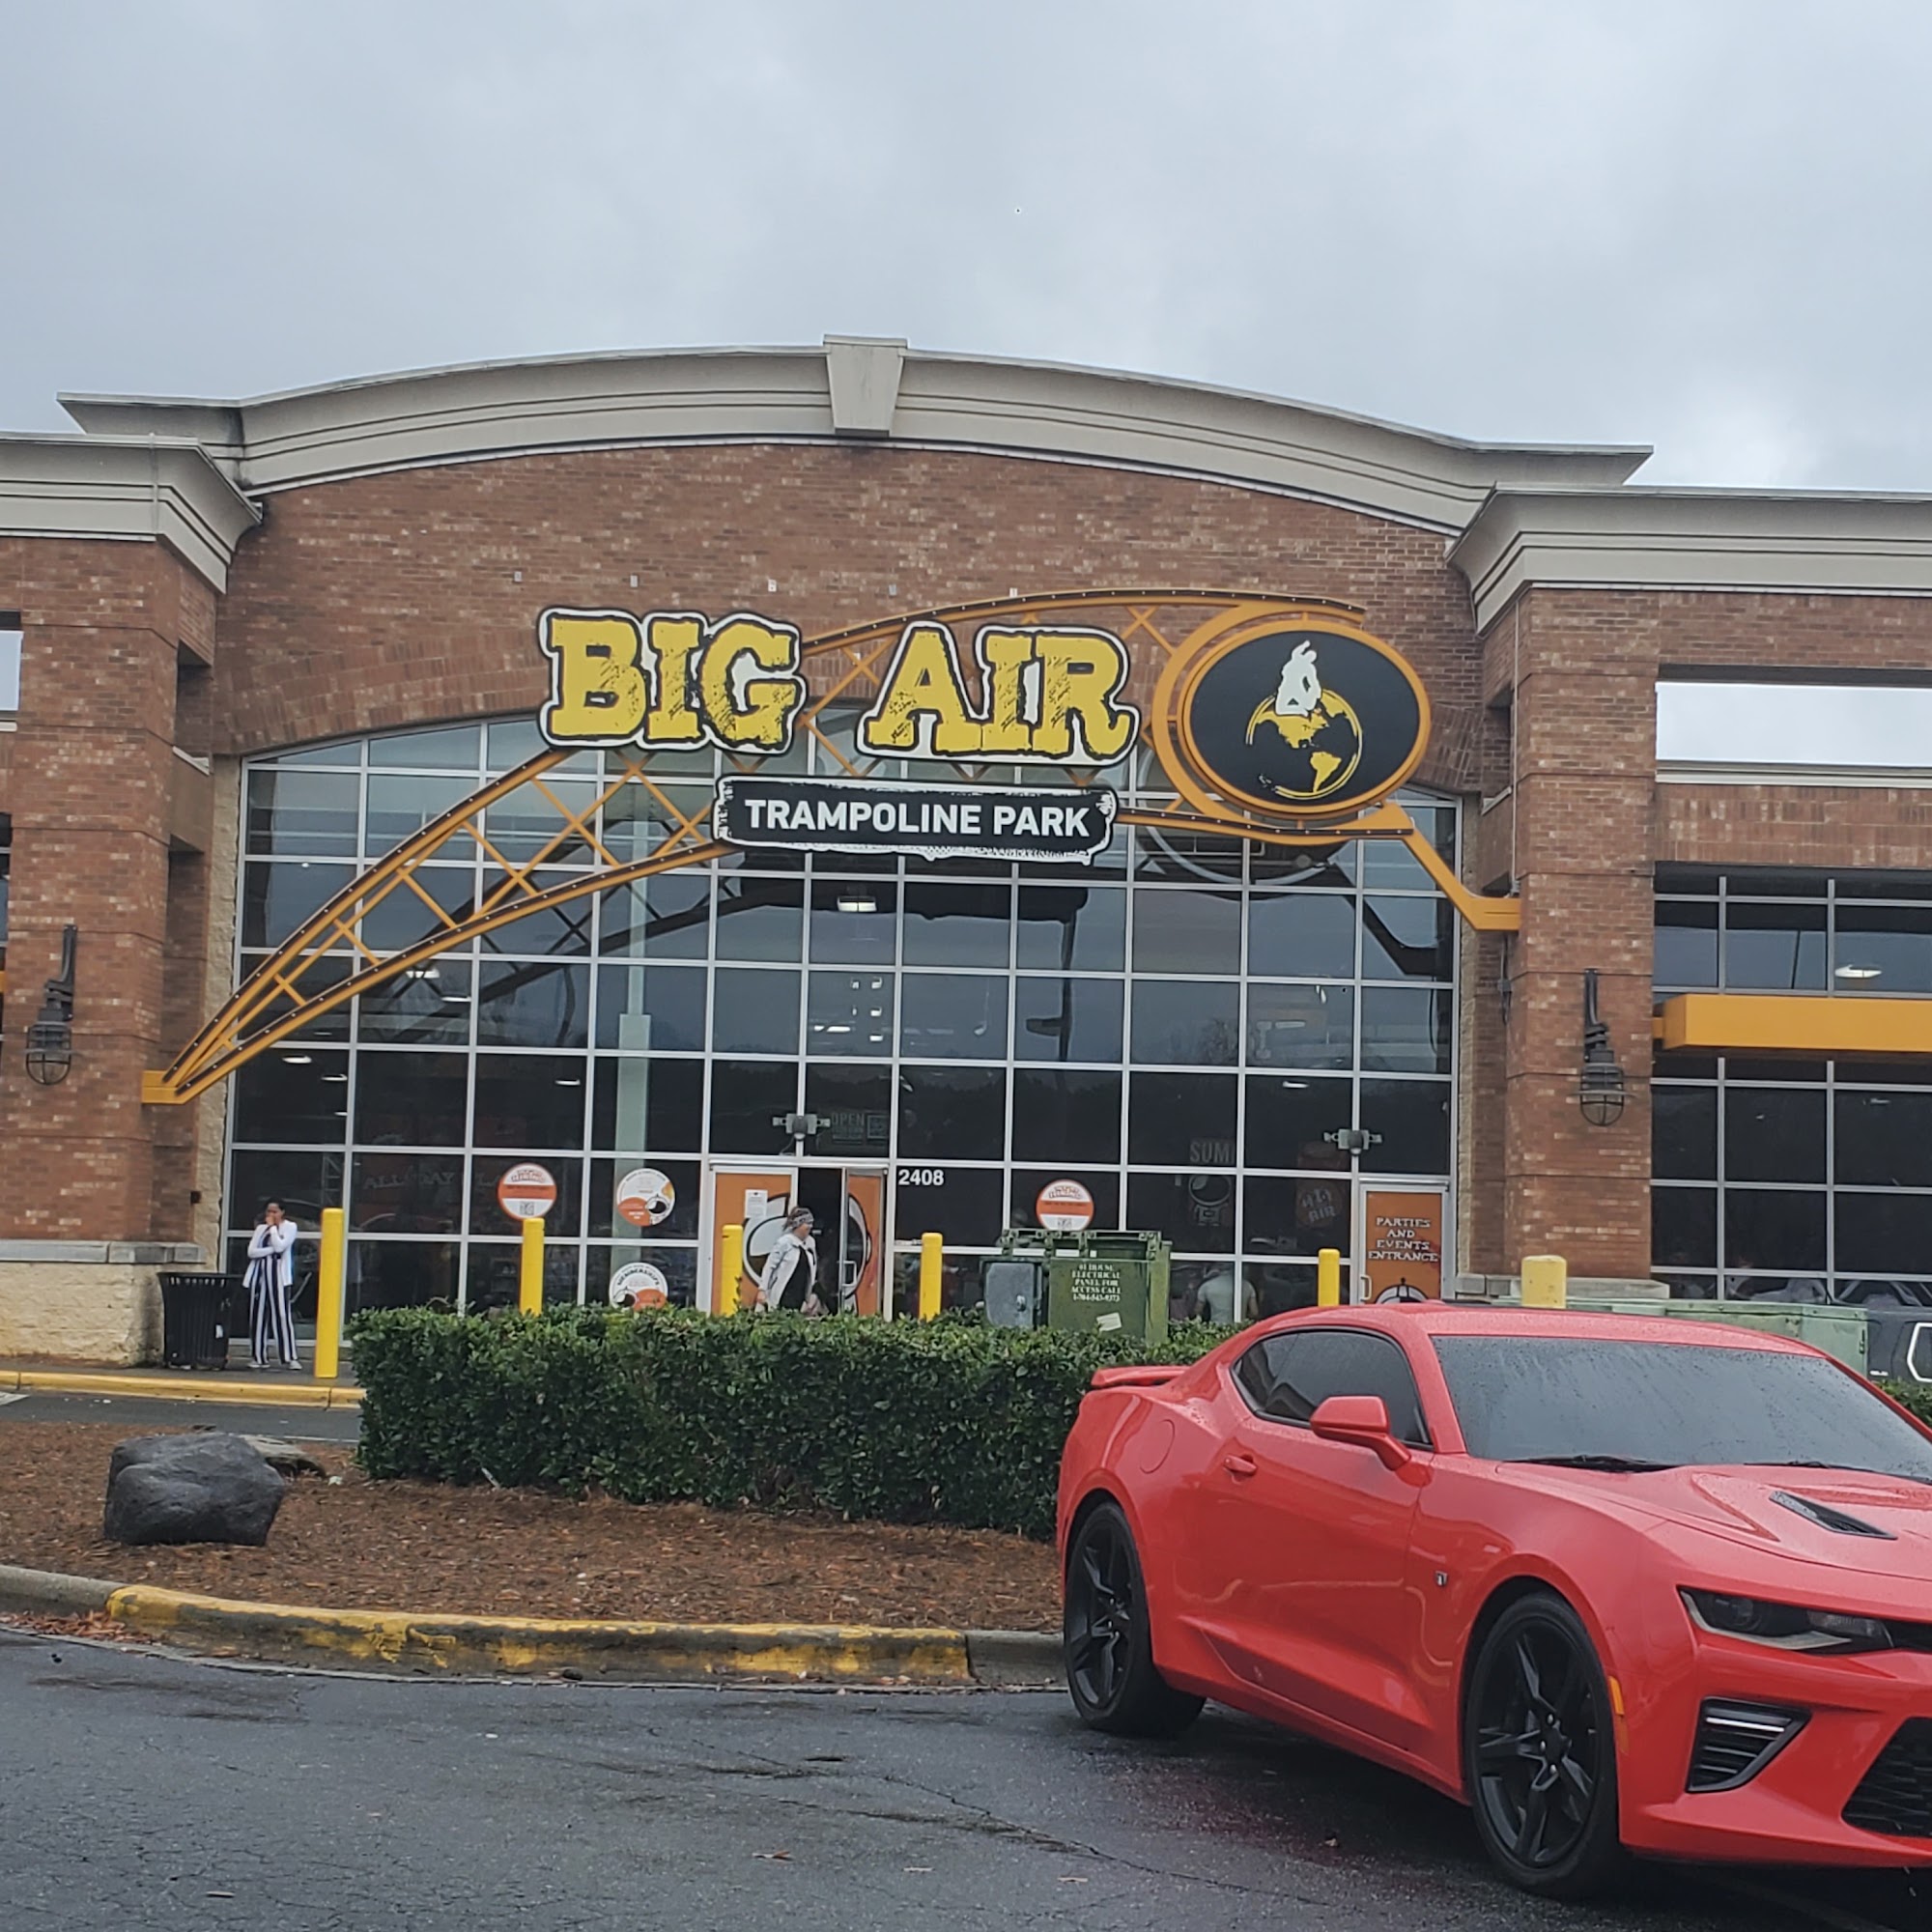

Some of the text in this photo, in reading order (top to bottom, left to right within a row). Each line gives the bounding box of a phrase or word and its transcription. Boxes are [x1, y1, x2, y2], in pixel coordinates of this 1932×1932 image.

[547, 614, 1136, 756] BIG AIR
[745, 799, 1090, 838] TRAMPOLINE PARK
[832, 1112, 865, 1126] OPEN
[898, 1169, 945, 1186] 2408
[1376, 1217, 1431, 1228] PARTIES
[1387, 1229, 1415, 1237] AND
[1377, 1239, 1430, 1250] EVENTS
[1368, 1250, 1438, 1262] ENTRANCE
[1071, 1270, 1121, 1279] ELECTRICAL
